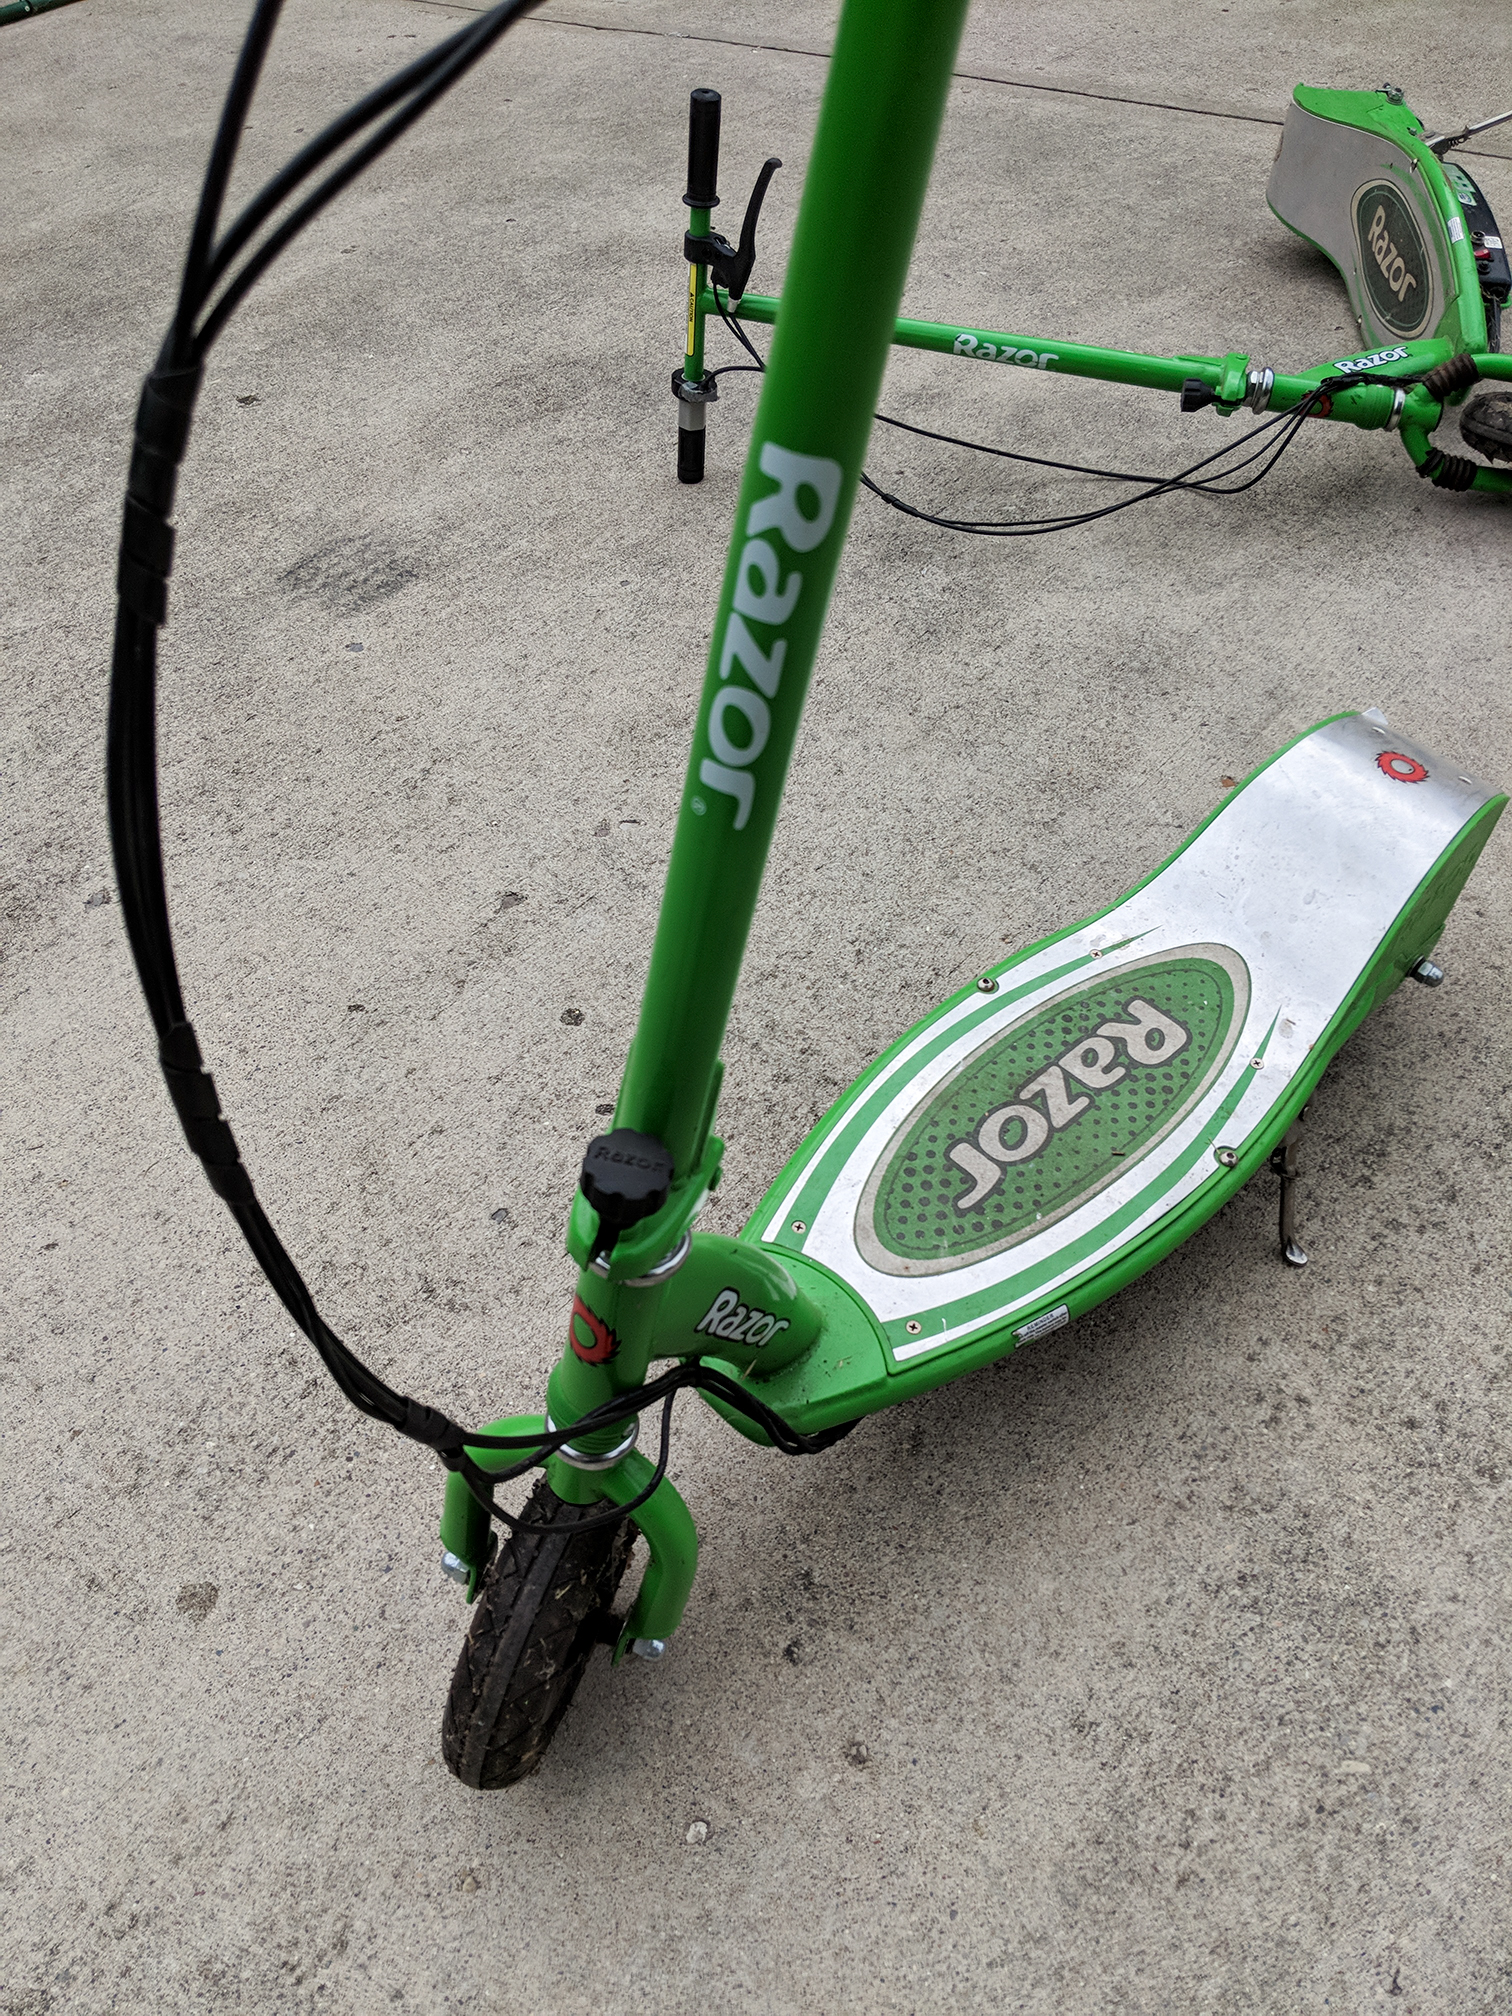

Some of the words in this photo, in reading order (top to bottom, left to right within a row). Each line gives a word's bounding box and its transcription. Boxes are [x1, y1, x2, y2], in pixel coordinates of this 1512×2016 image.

[1367, 205, 1417, 302] Razor
[953, 333, 1060, 369] Razor
[1332, 345, 1409, 374] Razor
[700, 441, 842, 831] Razor
[947, 998, 1189, 1212] Razor
[695, 1287, 791, 1347] Razor
